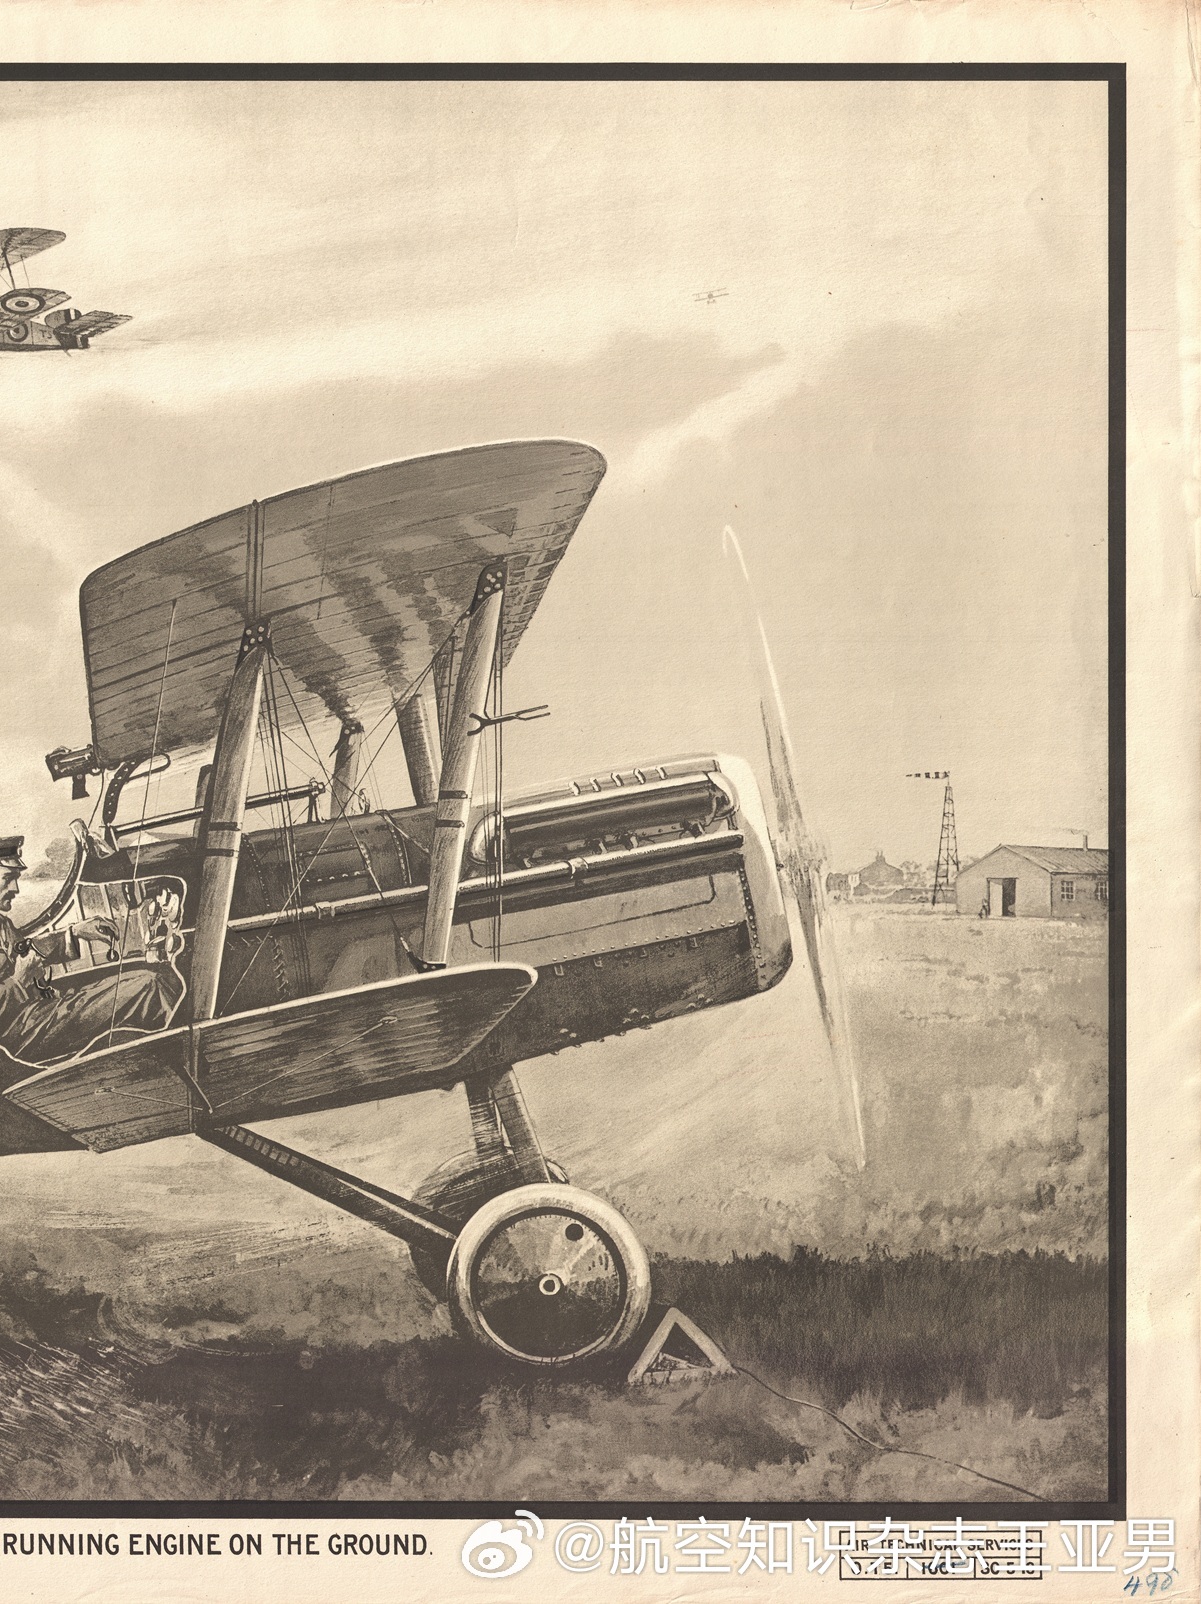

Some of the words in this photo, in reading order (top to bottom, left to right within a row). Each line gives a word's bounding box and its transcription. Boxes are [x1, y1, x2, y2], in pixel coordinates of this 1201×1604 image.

[3, 1532, 120, 1556] RUNNING
[129, 1532, 222, 1556] ENGINE
[229, 1532, 262, 1556] ON
[271, 1532, 320, 1556] THE
[327, 1532, 433, 1556] GROUND.
